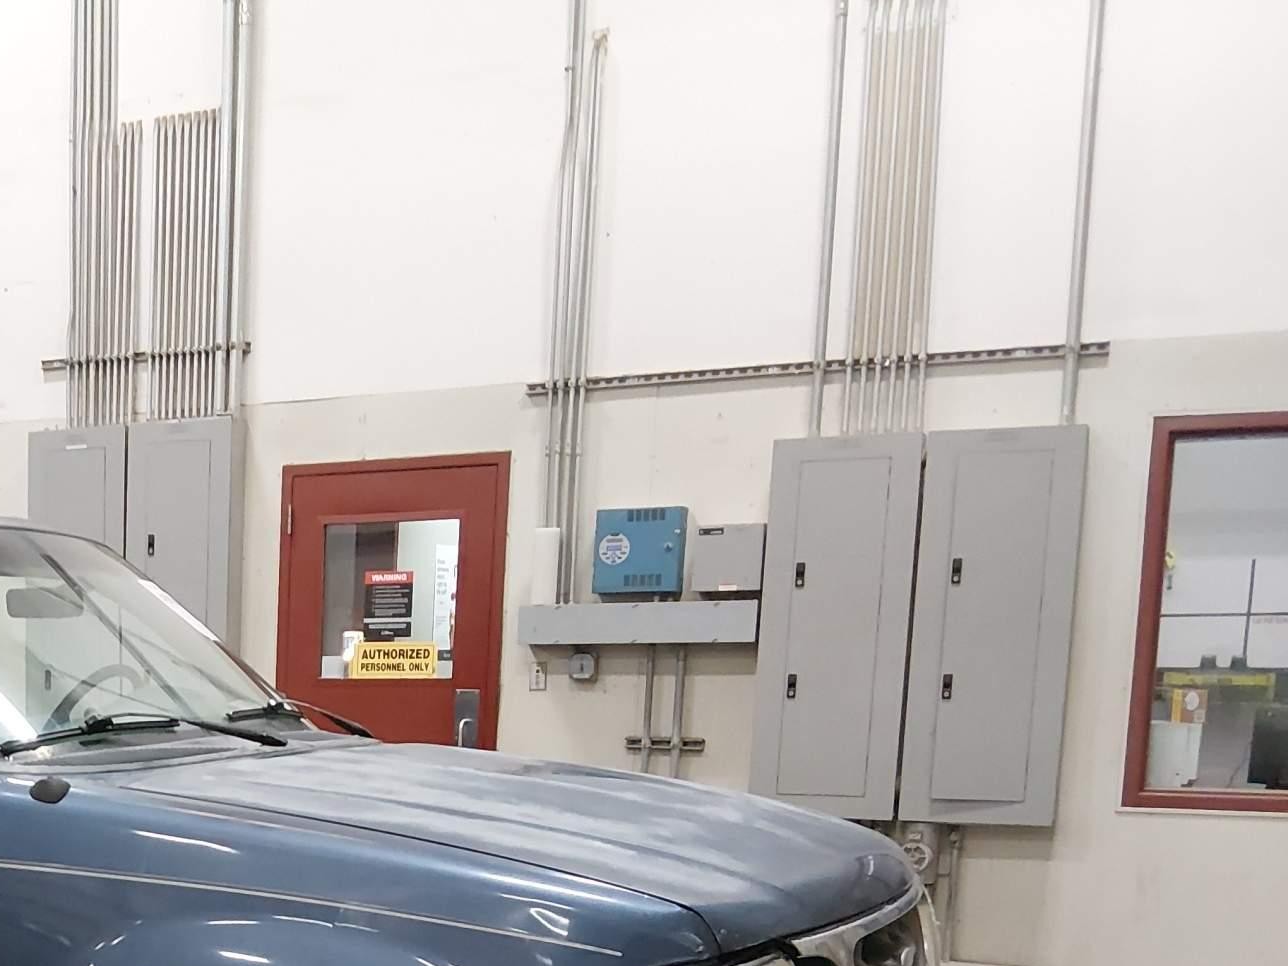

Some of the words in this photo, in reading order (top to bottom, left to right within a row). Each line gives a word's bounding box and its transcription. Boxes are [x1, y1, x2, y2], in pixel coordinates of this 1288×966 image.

[372, 573, 408, 582] WARNING
[361, 648, 431, 660] AUTHORIZED
[360, 662, 406, 672] PERSONNEL
[408, 662, 430, 672] ONLY
